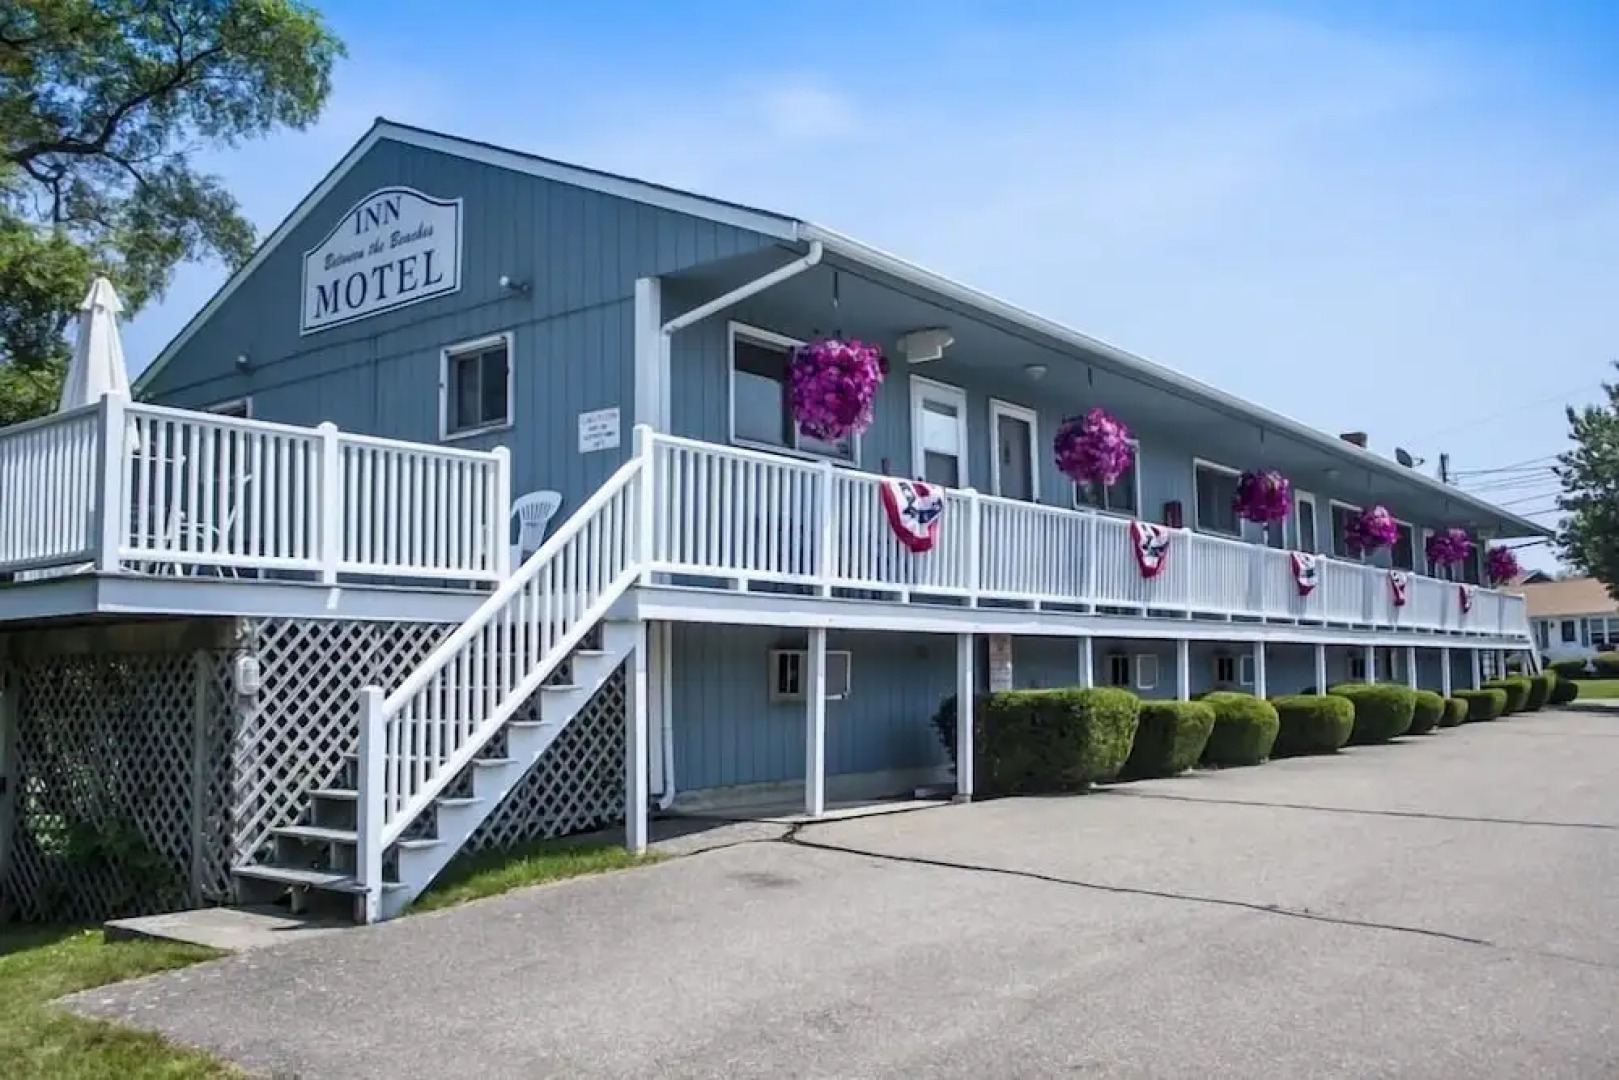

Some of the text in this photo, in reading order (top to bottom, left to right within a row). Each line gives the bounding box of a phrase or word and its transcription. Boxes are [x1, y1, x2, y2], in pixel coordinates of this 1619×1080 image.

[355, 196, 402, 236] INN
[368, 236, 385, 255] the
[313, 248, 443, 319] MOTEL
